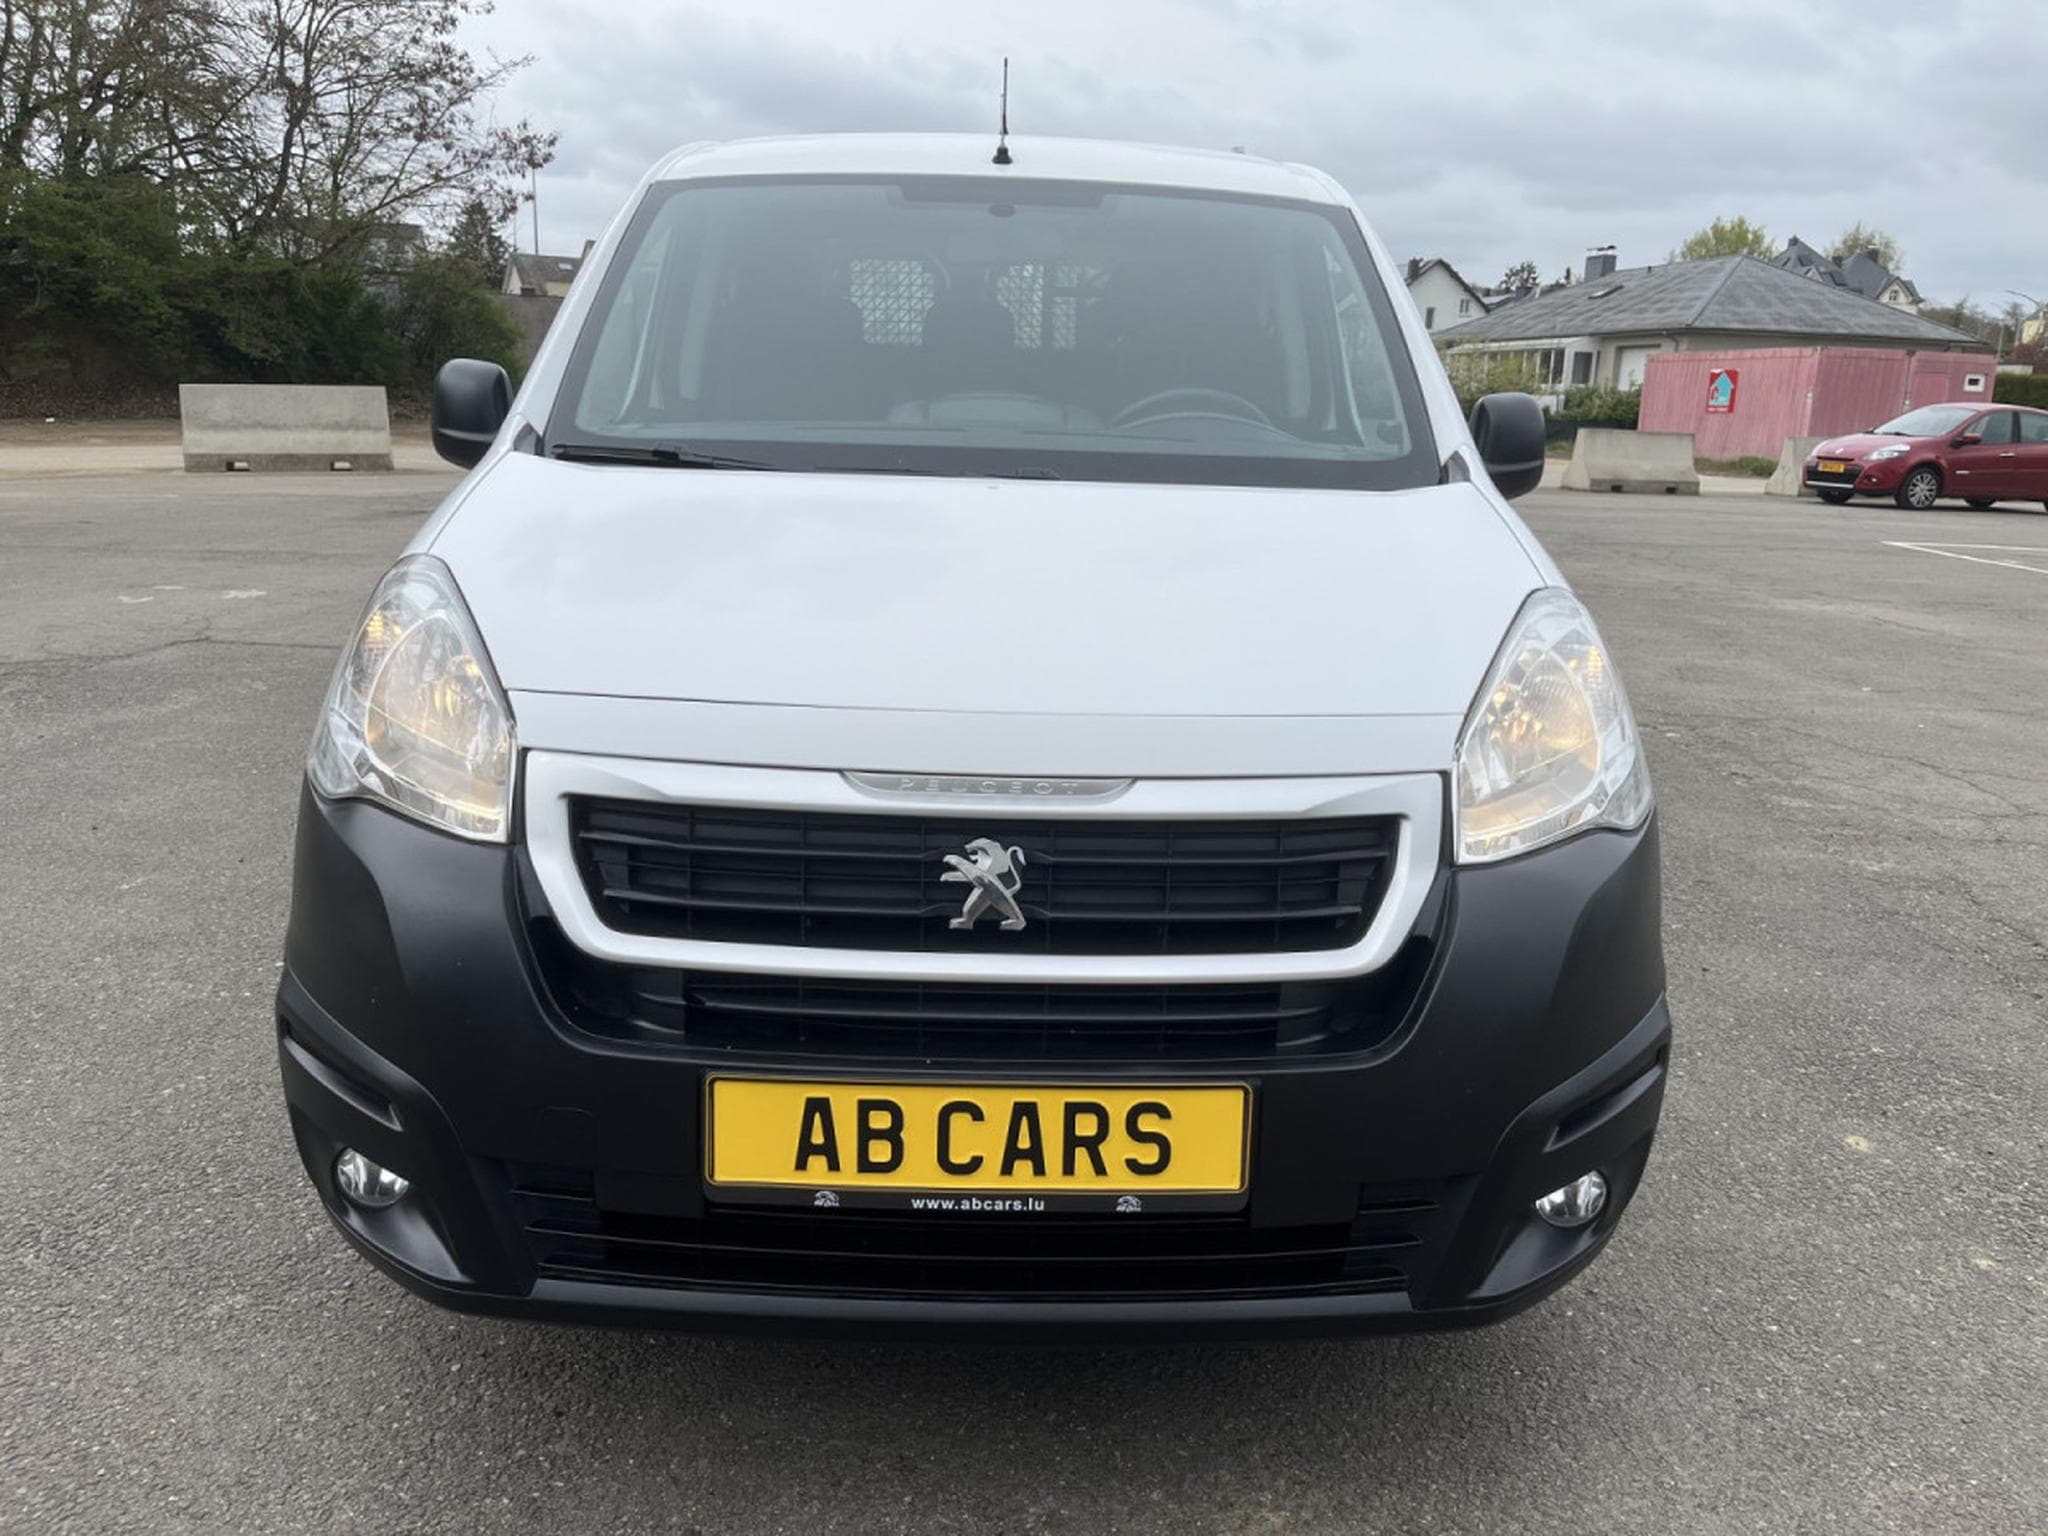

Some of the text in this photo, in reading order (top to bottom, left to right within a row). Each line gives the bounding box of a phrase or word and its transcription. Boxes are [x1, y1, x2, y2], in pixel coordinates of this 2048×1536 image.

[899, 777, 1079, 796] PEUGEOT
[795, 1096, 1173, 1177] AB CARS
[911, 1196, 1046, 1211] www.abcars.lu
